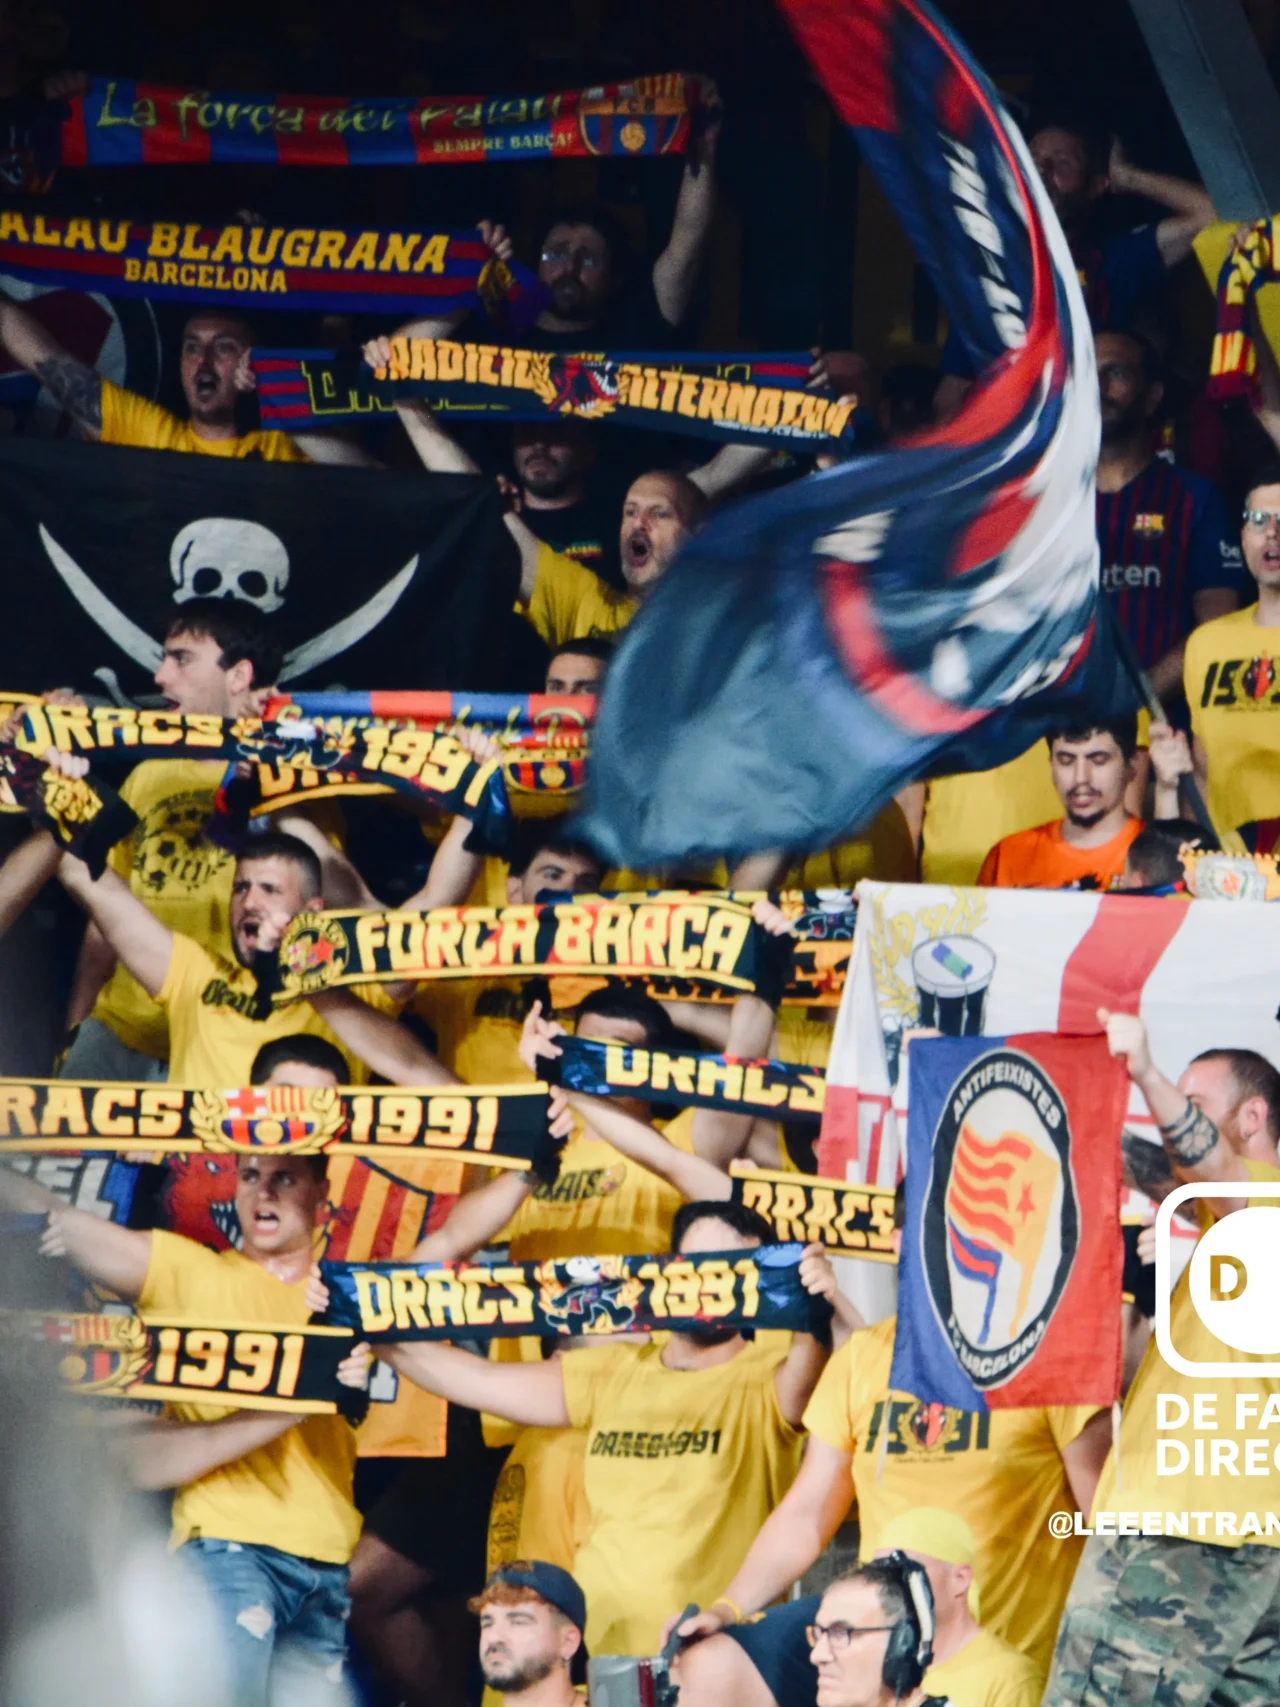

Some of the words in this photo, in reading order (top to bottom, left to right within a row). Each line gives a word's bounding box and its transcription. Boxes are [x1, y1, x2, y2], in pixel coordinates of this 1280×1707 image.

[96, 80, 158, 128] La
[171, 91, 303, 142] força
[433, 137, 505, 155] SEMPRE
[510, 133, 577, 155] BARÇA!
[124, 259, 289, 294] BARCELONA
[147, 223, 449, 273] BLAUGRANA
[356, 906, 540, 974] FORÇA
[554, 902, 754, 978] BARÇA
[351, 1094, 498, 1152] 1991
[953, 1061, 1062, 1129] ANTIFEIXISTES
[353, 1268, 535, 1333] DRACS
[637, 1258, 760, 1320] 1991
[154, 1328, 304, 1397] 1991
